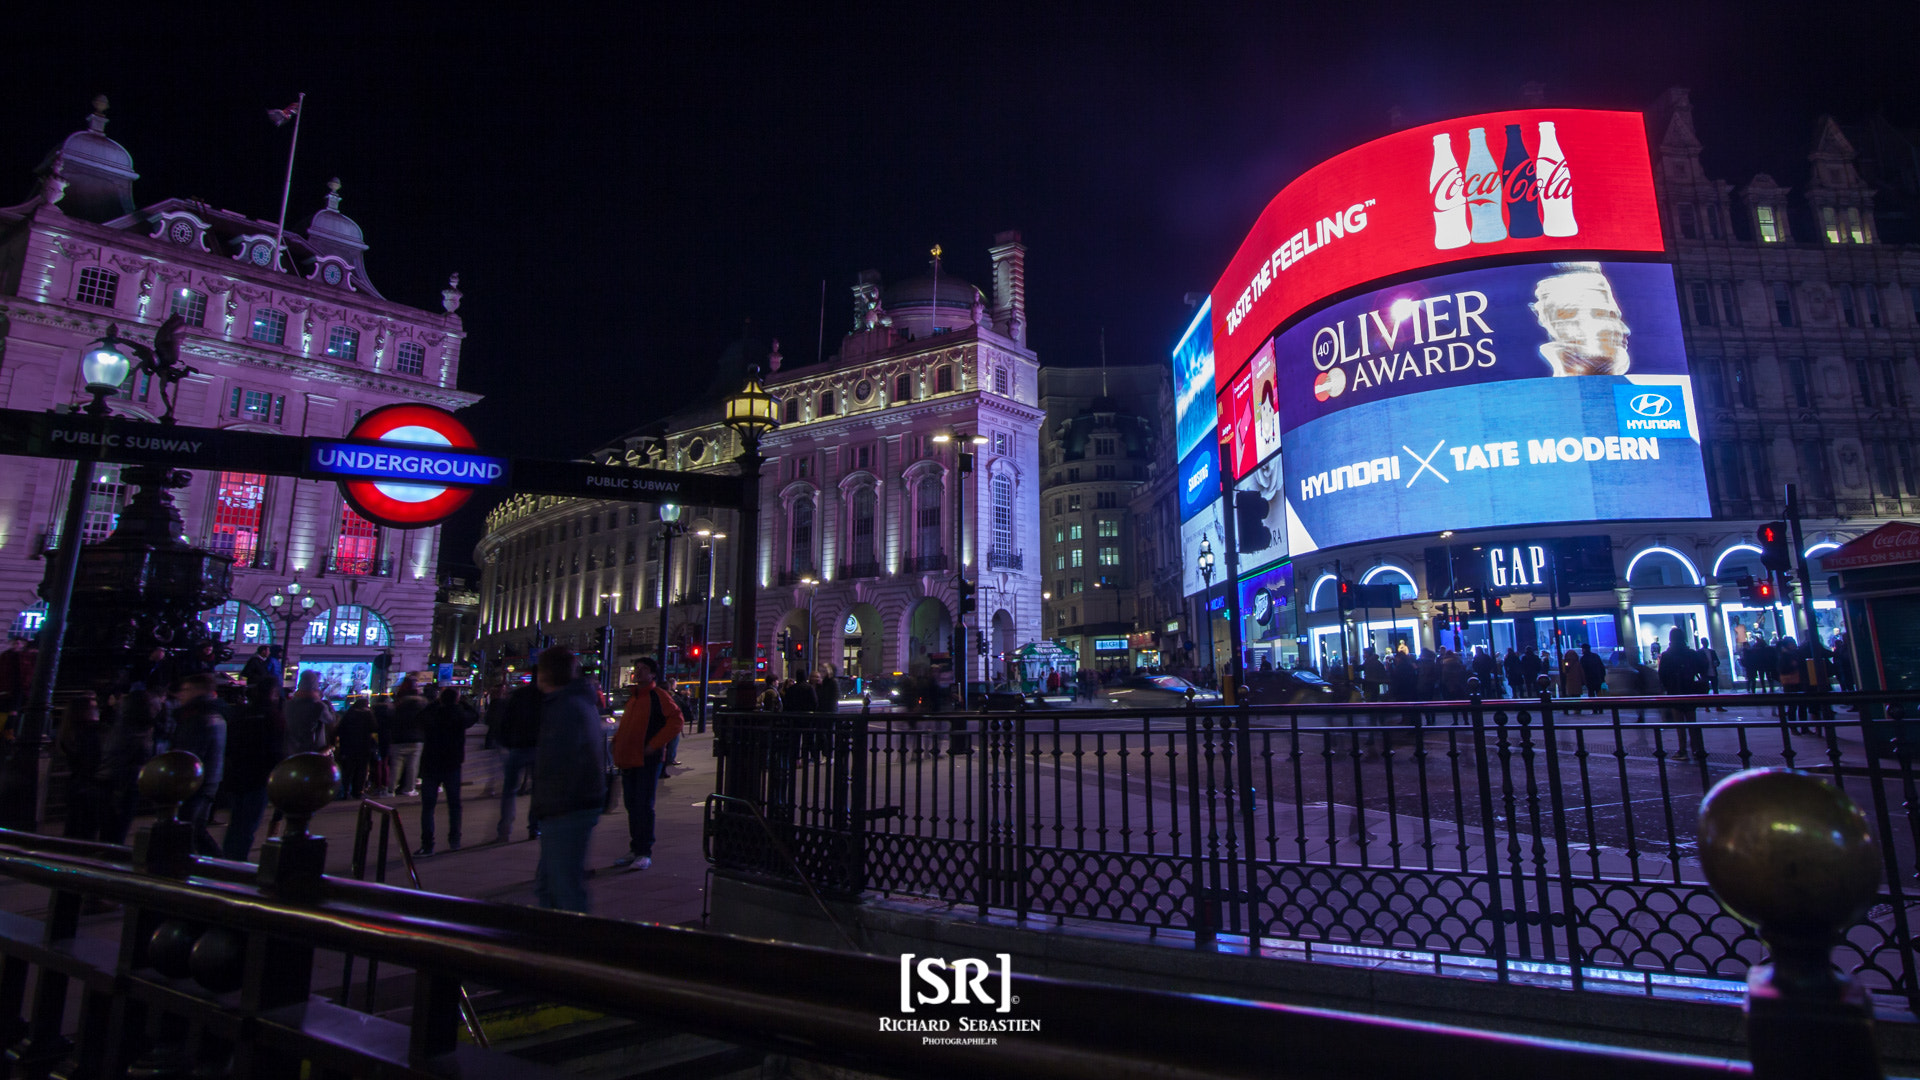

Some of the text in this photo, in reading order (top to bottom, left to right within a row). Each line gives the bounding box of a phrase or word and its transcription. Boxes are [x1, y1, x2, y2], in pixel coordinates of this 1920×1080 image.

[1226, 286, 1252, 336] TASTE
[1251, 259, 1271, 302] THE
[1312, 290, 1494, 371] OLIVIER
[1352, 338, 1497, 391] AWARDS
[1627, 419, 1681, 430] HYUNDAI
[51, 429, 202, 453] PUBLIC SUBWAY
[316, 448, 503, 480] UNDERGROUND
[1188, 464, 1208, 492] SAMSUNG
[1301, 456, 1401, 501] HYUNDAI
[1450, 441, 1520, 472] TATE
[1528, 436, 1660, 465] MODERN
[586, 475, 680, 492] PUBLIC SUBWAY
[1490, 546, 1545, 587] GAP
[1830, 553, 1869, 566] TICKETS
[1870, 552, 1887, 562] ON
[1889, 550, 1913, 560] SALE
